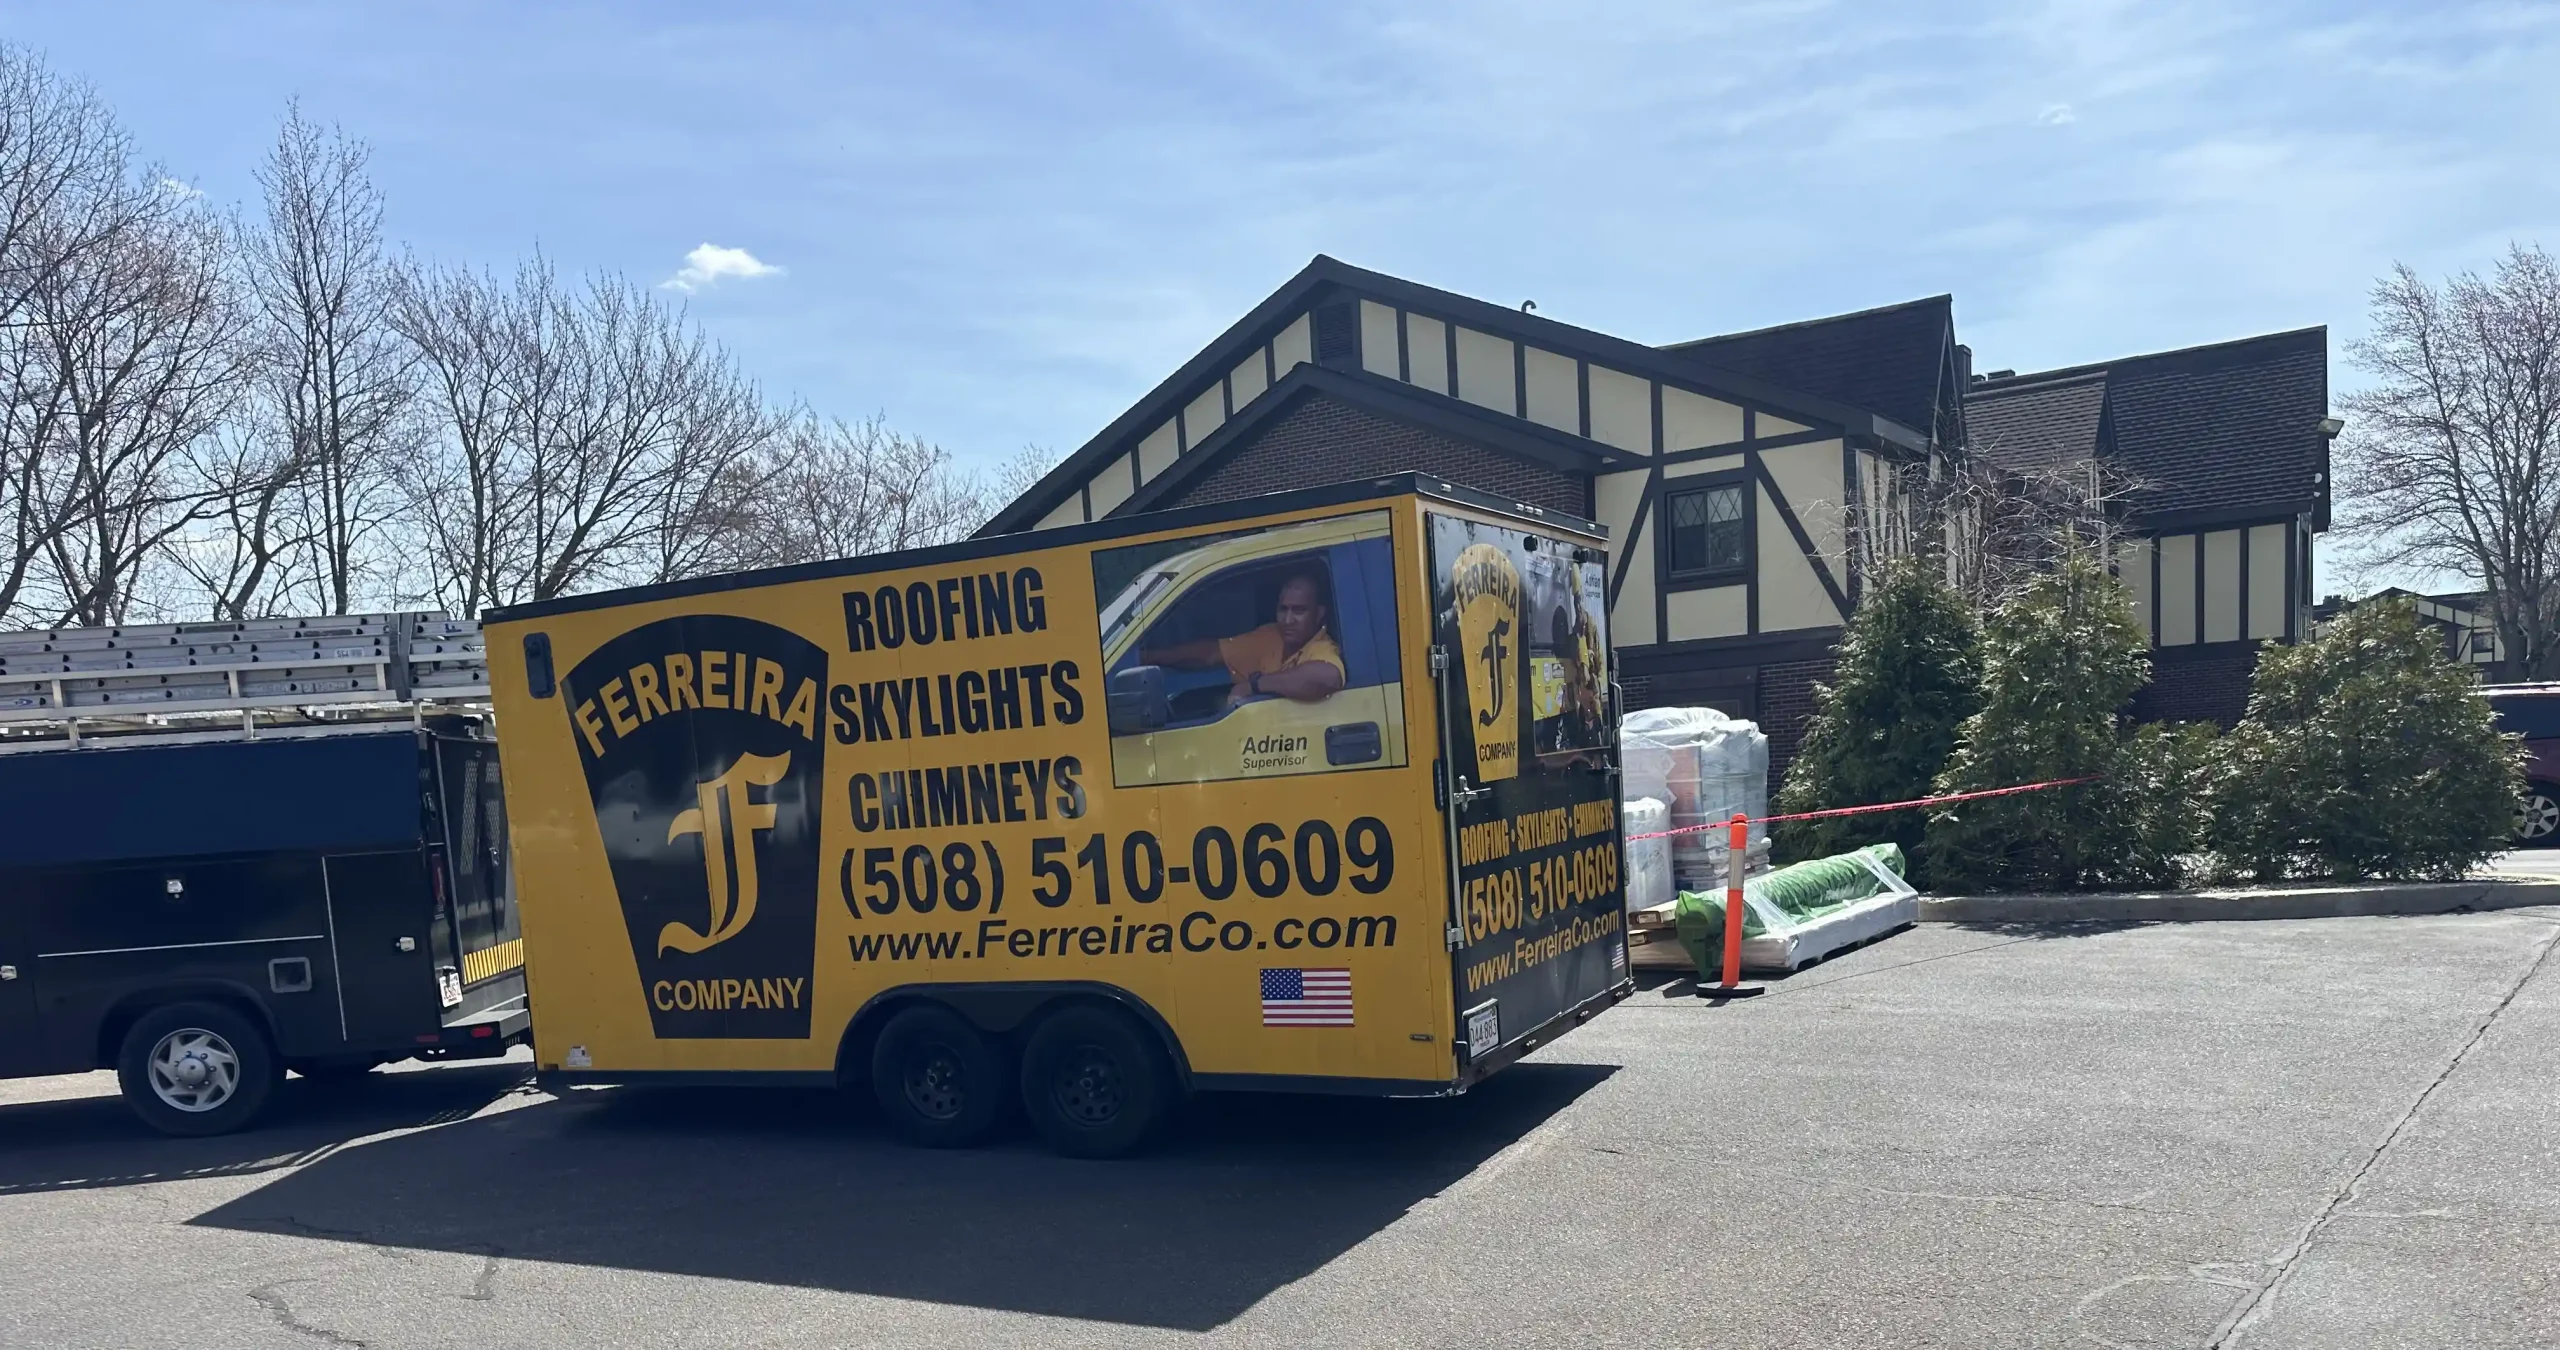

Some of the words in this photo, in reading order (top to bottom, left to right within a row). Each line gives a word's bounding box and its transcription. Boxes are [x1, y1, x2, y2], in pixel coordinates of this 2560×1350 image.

[842, 567, 1047, 652] ROOFING
[1456, 562, 1517, 617] FERREIRA
[574, 651, 818, 758] FERREIRA
[831, 660, 1084, 746] SKYLIGHTS
[1242, 734, 1307, 755] Adrian
[1243, 755, 1307, 770] Supervisor
[1479, 742, 1516, 762] COMPANY
[848, 756, 1087, 833] CHIMNEYS
[840, 834, 1005, 919] (508)
[1031, 816, 1394, 908] 510-0609
[1460, 819, 1509, 867] ROOFING
[1516, 807, 1568, 852] SKYLIGHTS
[1573, 798, 1615, 838] CHIMNEYS
[1462, 867, 1523, 947] (508)
[1530, 842, 1617, 919] 510-0609
[848, 911, 1398, 962] www.FerreiraCo.com
[1467, 910, 1619, 993] www.FerreiraCo.com
[653, 977, 804, 1011] COMPANY
